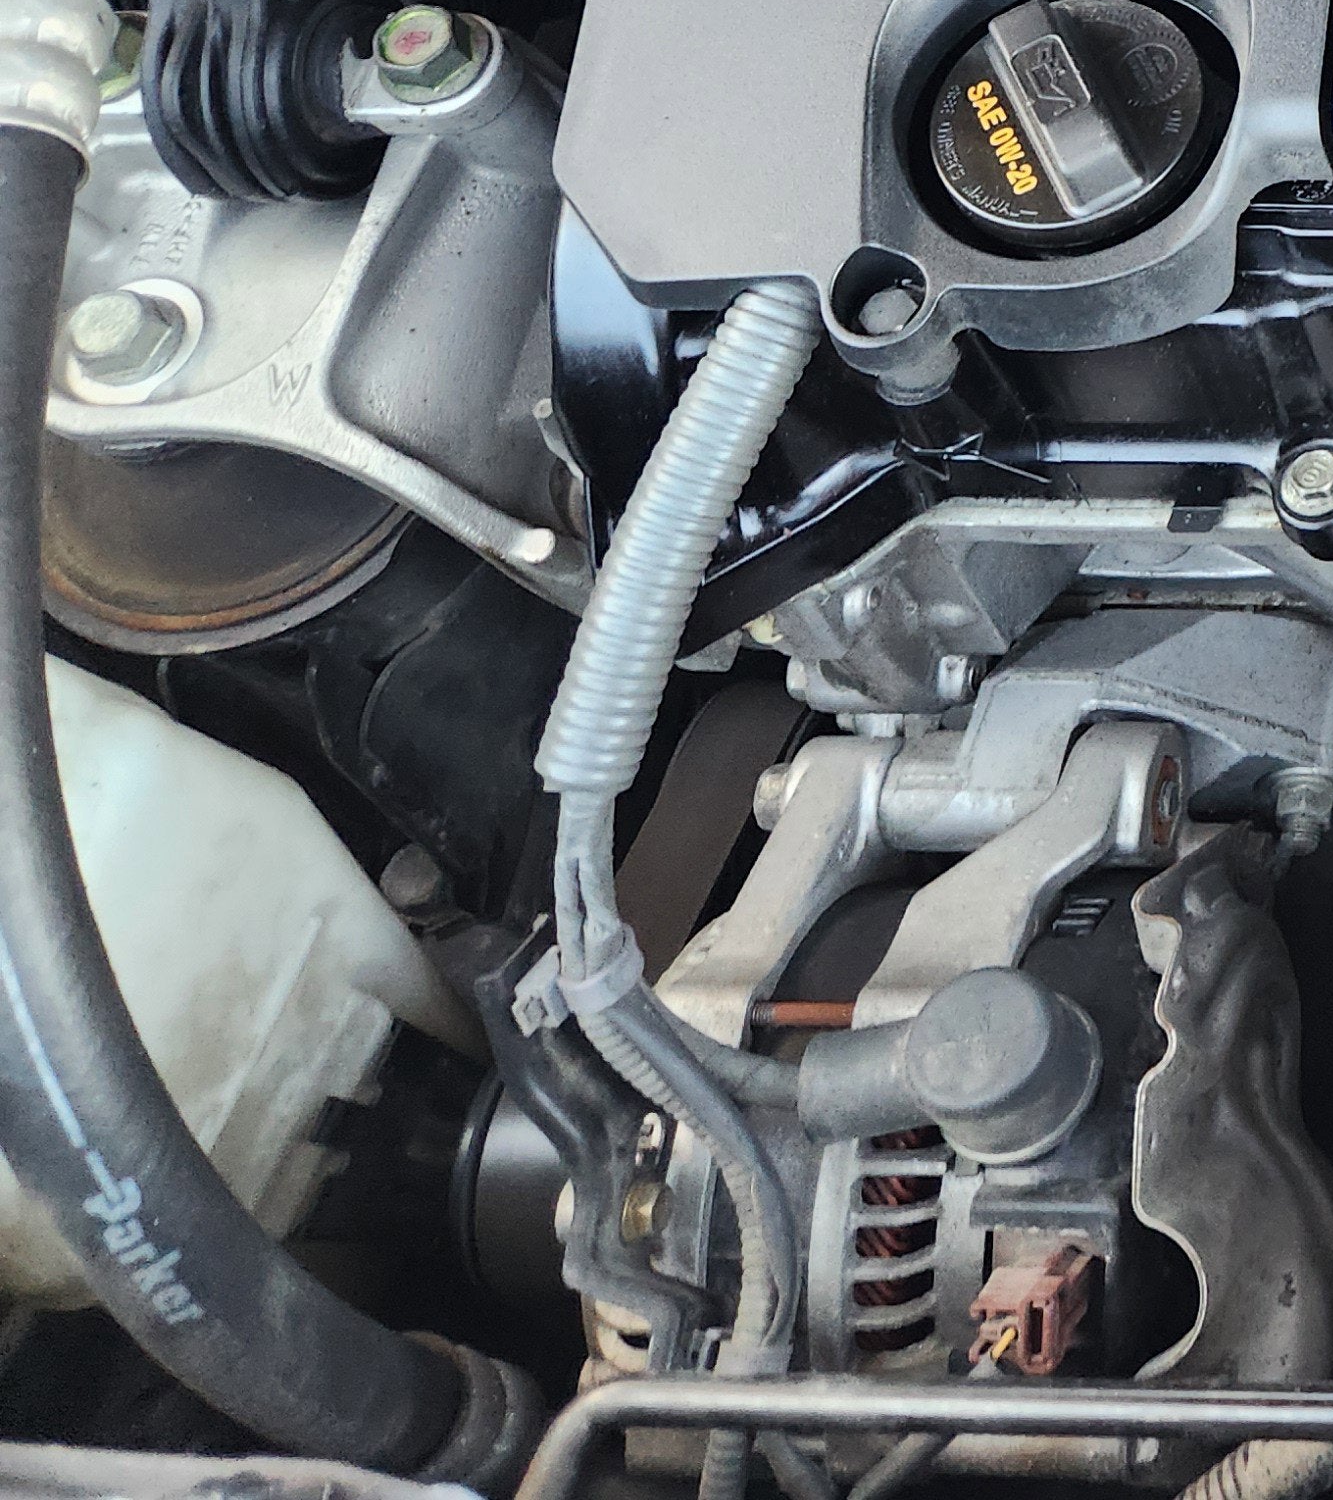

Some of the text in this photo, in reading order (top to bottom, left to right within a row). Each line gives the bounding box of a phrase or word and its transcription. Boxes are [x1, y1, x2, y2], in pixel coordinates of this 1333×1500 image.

[966, 79, 1039, 196] SAE 0W-20
[83, 1152, 205, 1325] Parker
